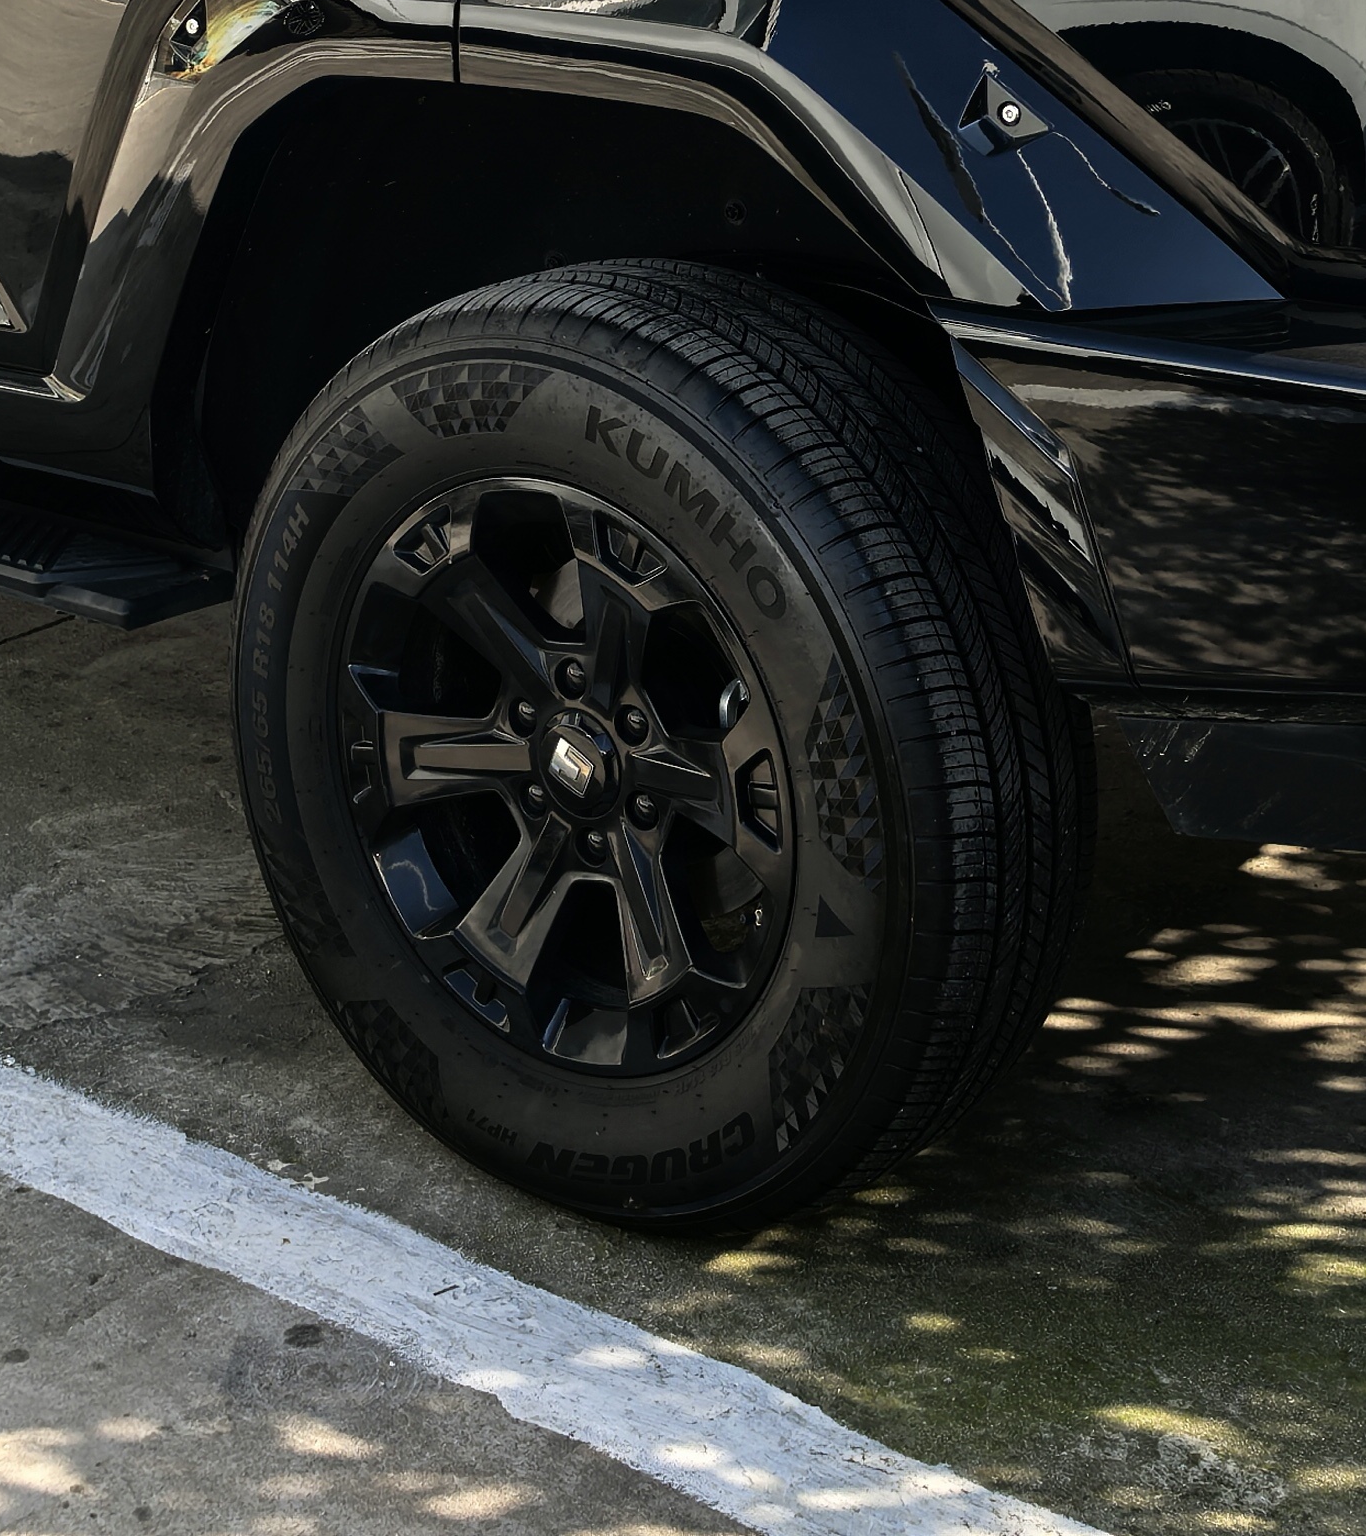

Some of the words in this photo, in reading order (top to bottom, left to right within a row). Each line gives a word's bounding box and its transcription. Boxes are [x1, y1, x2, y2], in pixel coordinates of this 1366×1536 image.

[266, 502, 310, 593] 114H
[585, 404, 786, 621] KUMHO
[251, 600, 284, 681] R18
[251, 692, 284, 826] 265/65
[466, 1108, 518, 1147] HP71
[526, 1111, 756, 1186] CRUGEN
